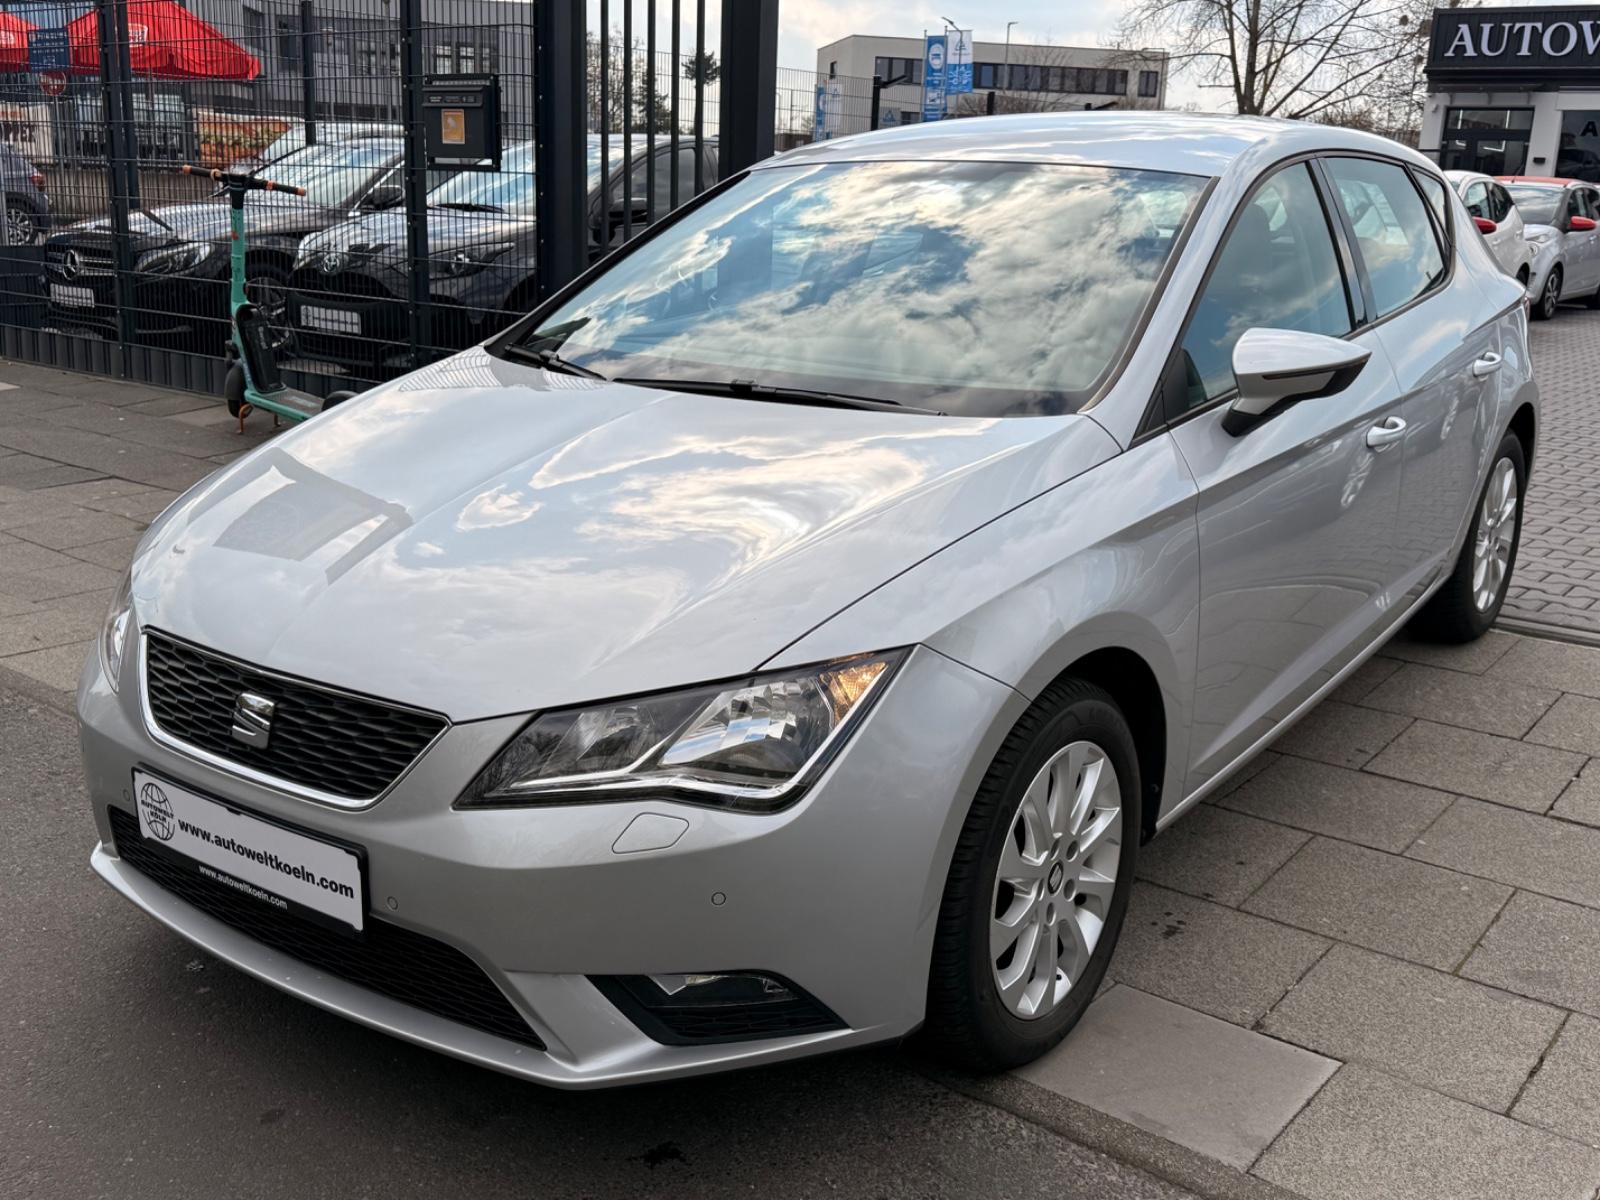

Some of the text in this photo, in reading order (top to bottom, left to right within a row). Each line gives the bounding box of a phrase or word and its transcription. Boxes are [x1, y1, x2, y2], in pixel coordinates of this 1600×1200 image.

[140, 799, 175, 820] AUTOWELT
[177, 818, 355, 899] www.autoweltkoeln.com
[198, 864, 288, 910] www.autoweltkoeln.com
